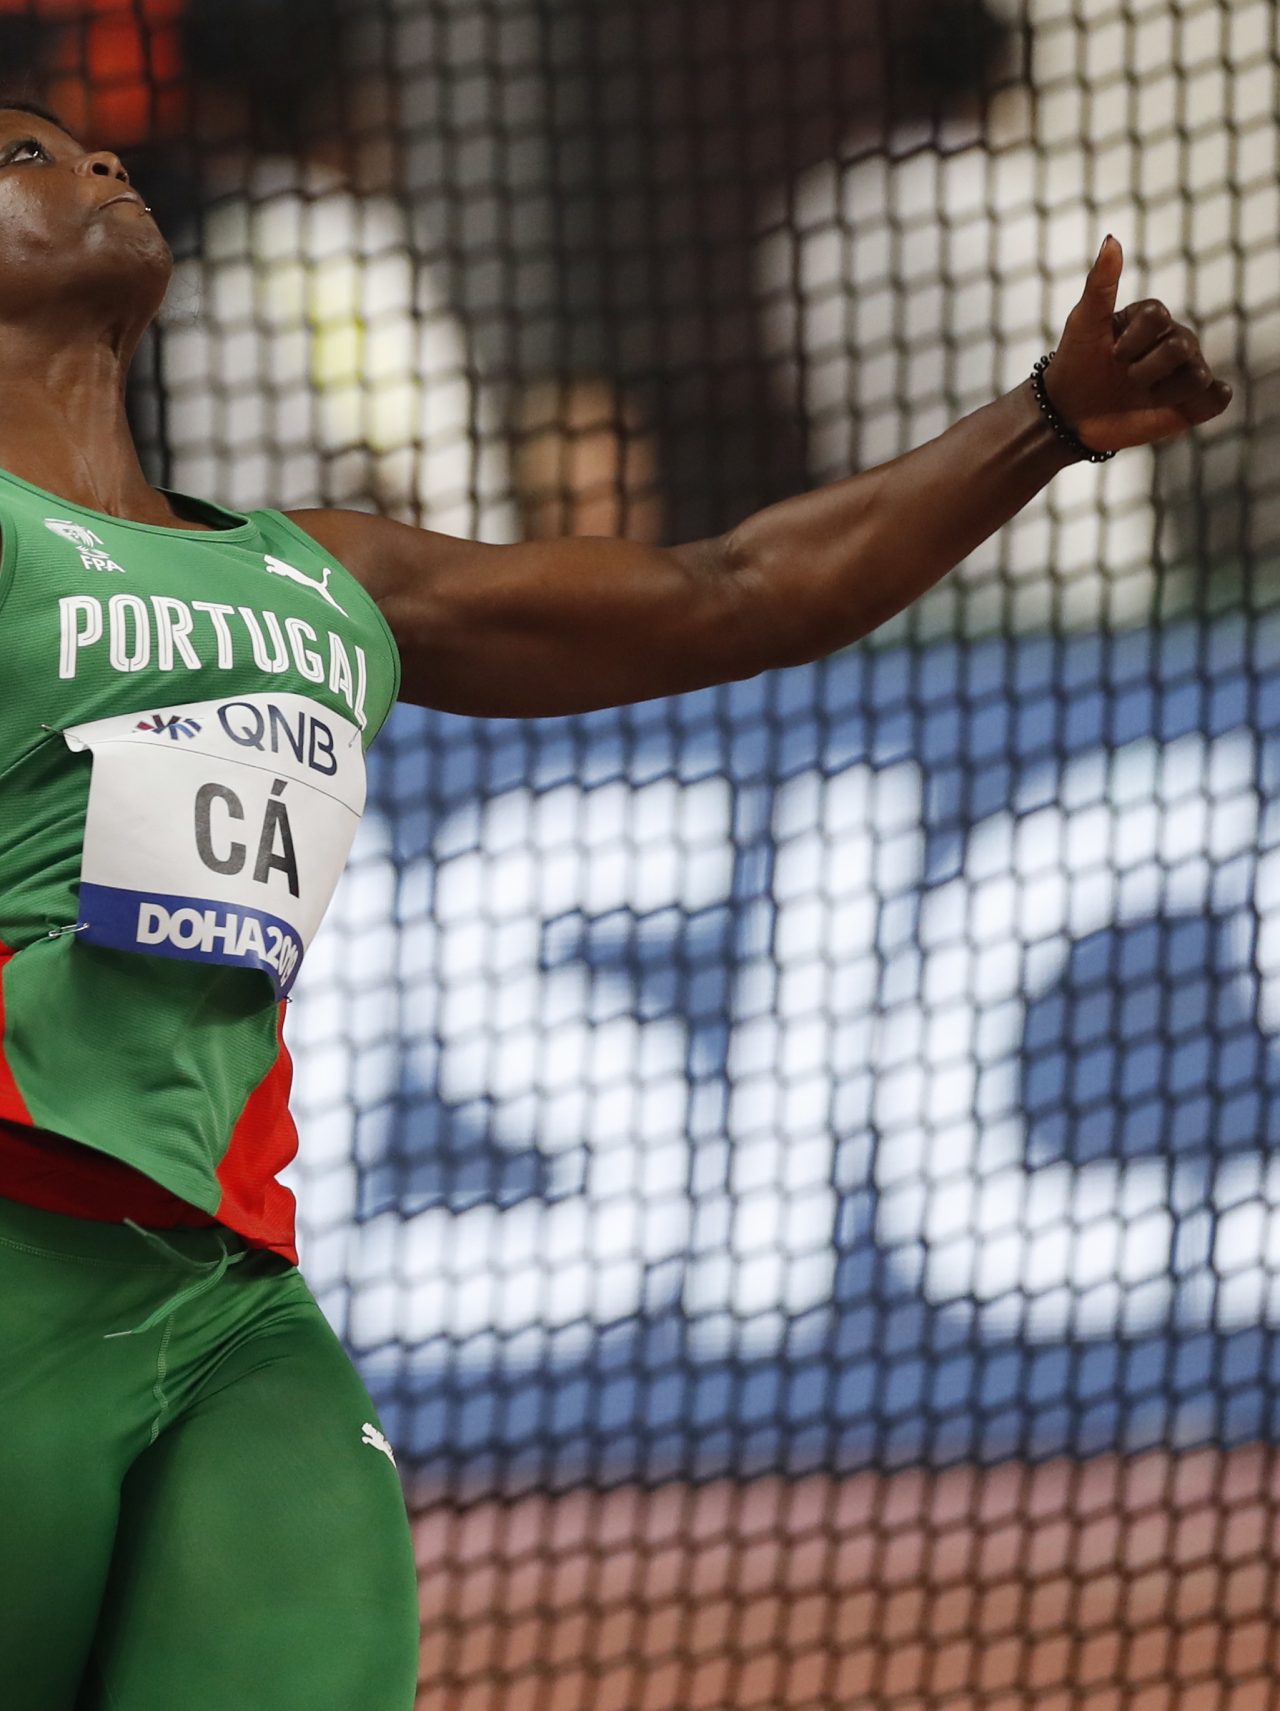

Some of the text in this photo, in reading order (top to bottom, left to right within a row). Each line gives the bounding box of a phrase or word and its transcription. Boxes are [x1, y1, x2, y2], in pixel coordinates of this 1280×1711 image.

[80, 554, 126, 573] FPA
[58, 594, 368, 721] PORTUGAL
[217, 702, 338, 776] QNB
[194, 778, 300, 898] CÁ
